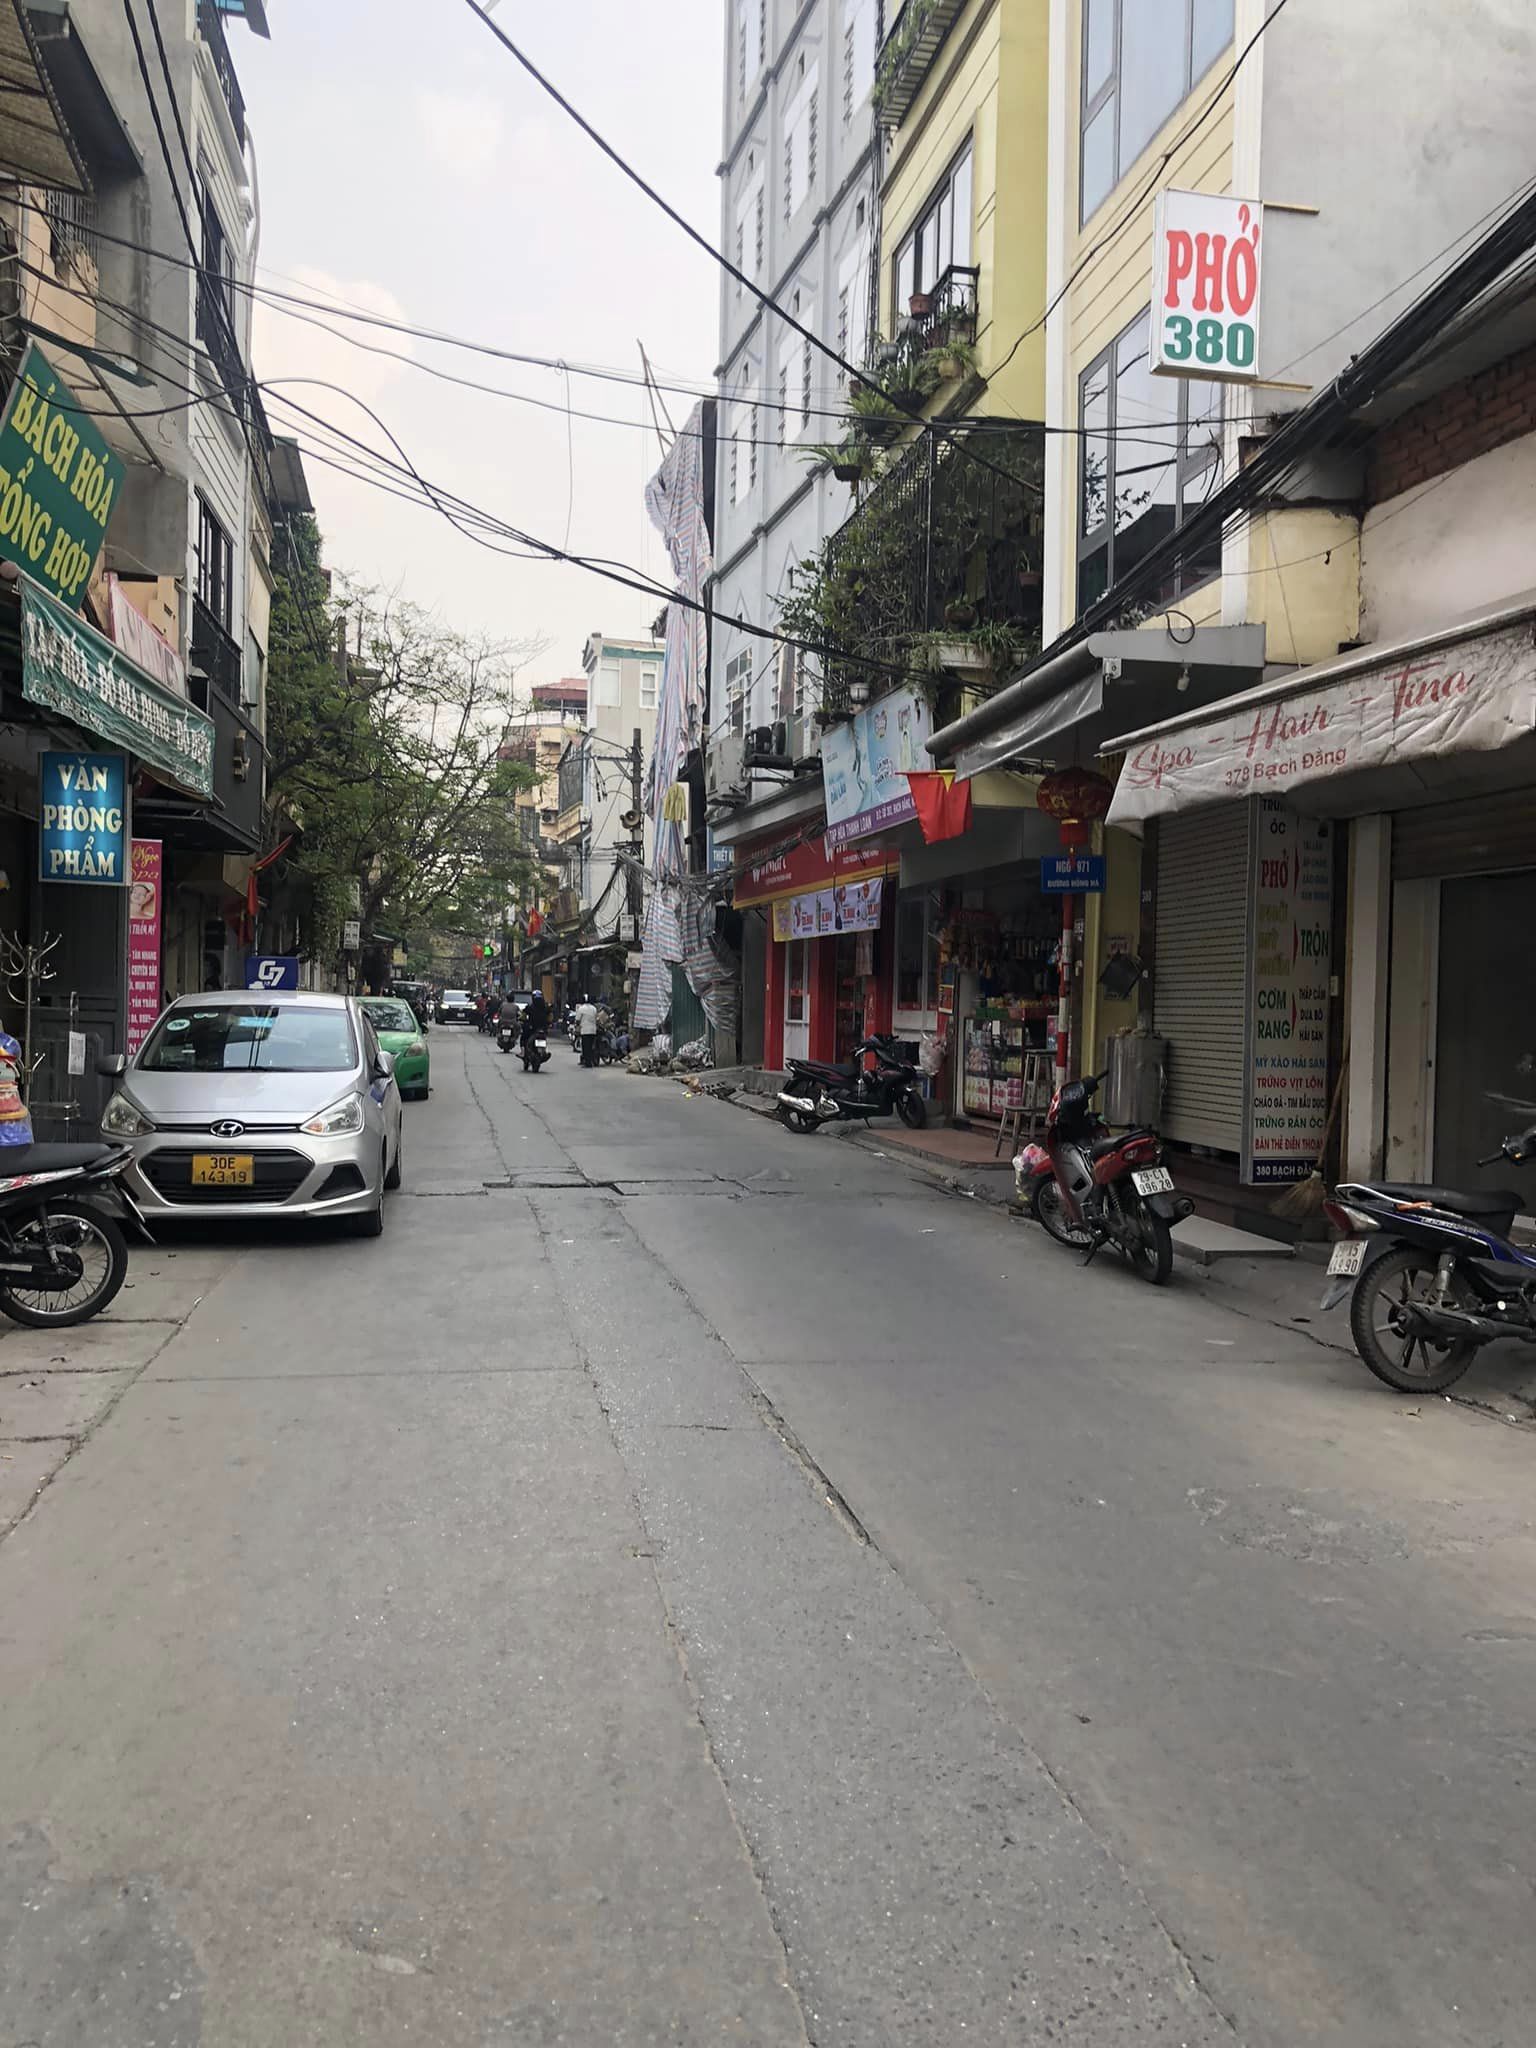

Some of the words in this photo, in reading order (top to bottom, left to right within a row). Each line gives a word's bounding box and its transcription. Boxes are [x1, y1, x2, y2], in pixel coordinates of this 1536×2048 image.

[1164, 203, 1260, 316] PHỞ
[1163, 314, 1256, 368] 380
[10, 374, 80, 484] BÁCH
[1126, 743, 1198, 789] Spa
[1232, 701, 1335, 758] Hair
[1383, 660, 1477, 726] Tina
[57, 757, 110, 793] VĂN
[1225, 766, 1251, 788] 378
[1253, 759, 1299, 782] Bạch
[1301, 747, 1348, 771] Đằng
[43, 799, 123, 834] PHÒNG
[50, 835, 117, 879] PHẨM
[1261, 847, 1289, 889] PHỞ
[1300, 921, 1329, 966] TRỘN
[258, 960, 285, 987] G7
[1257, 987, 1287, 1009] CƠM
[1257, 1019, 1291, 1039] RANG
[1256, 1074, 1287, 1089] TRỨNG
[1289, 1078, 1303, 1092] VỊT
[1288, 1114, 1307, 1129] RÁN
[1254, 1136, 1269, 1150] BÁN
[1271, 1134, 1283, 1151] THẺ
[210, 1156, 237, 1170] 30E
[1137, 1168, 1165, 1183] 29-C1
[1256, 1166, 1271, 1176] 380
[1272, 1165, 1296, 1180] BẠCH
[200, 1170, 248, 1184] 143.19
[1139, 1178, 1172, 1194] 096.28
